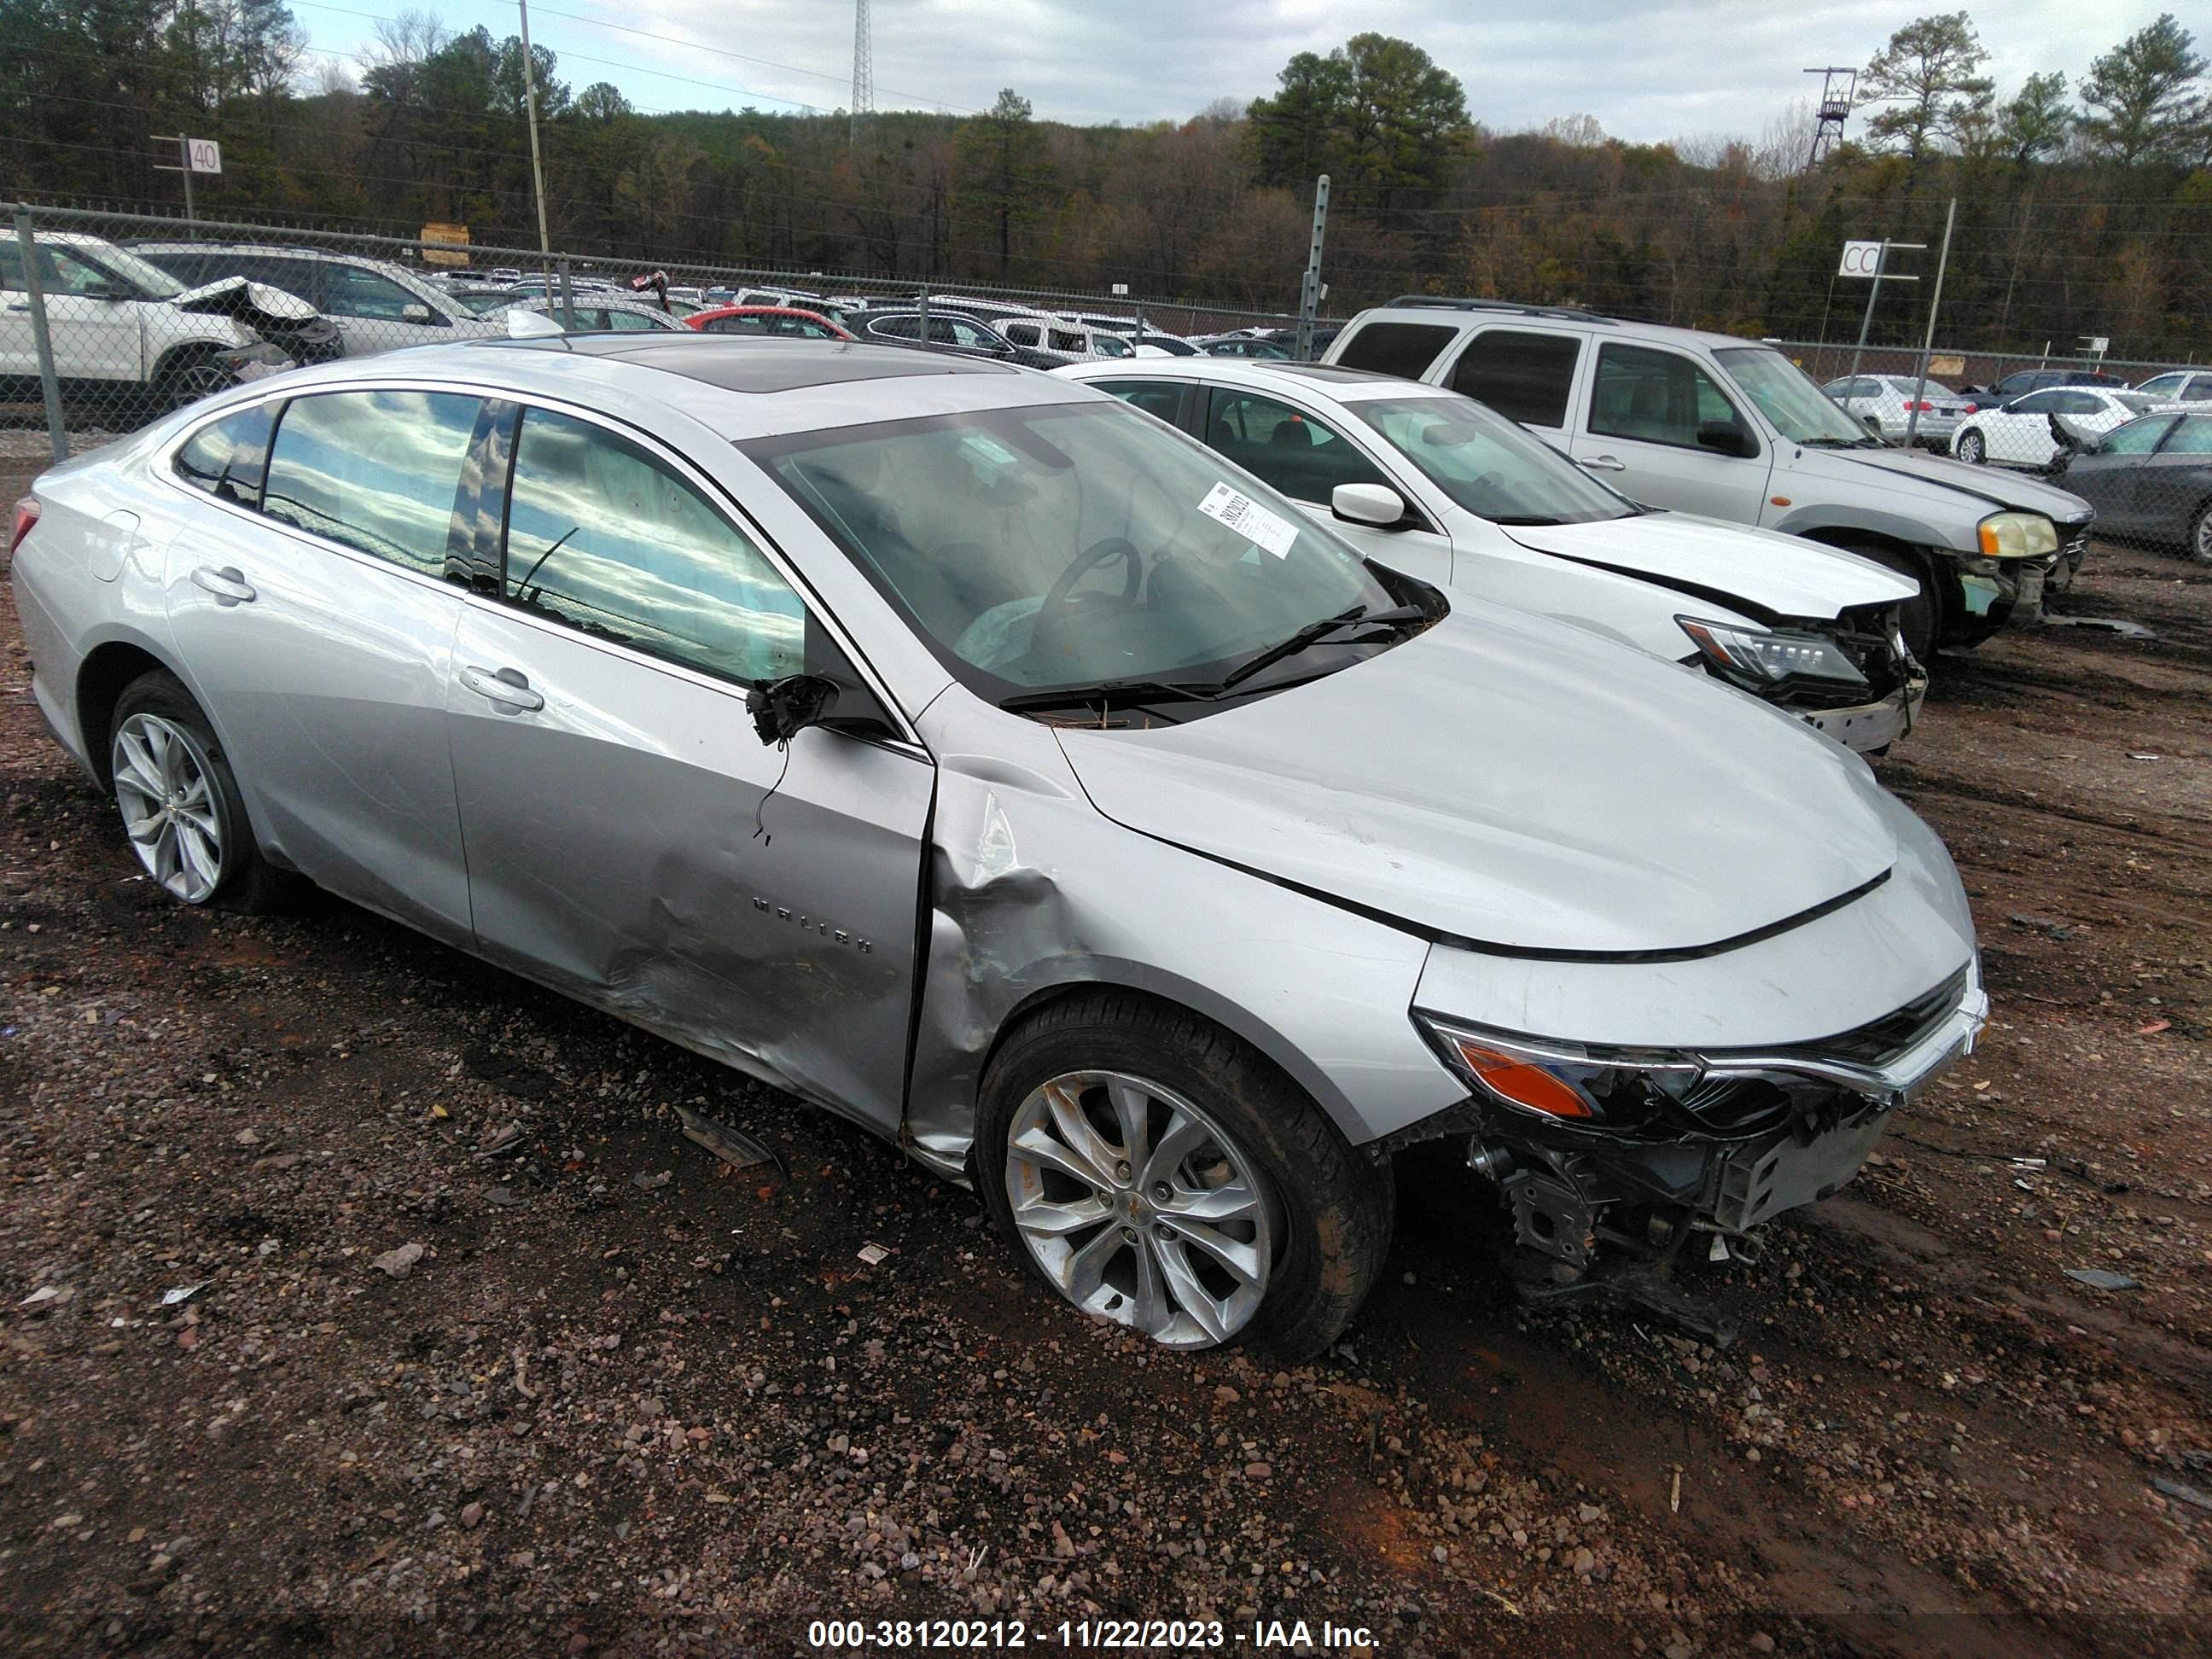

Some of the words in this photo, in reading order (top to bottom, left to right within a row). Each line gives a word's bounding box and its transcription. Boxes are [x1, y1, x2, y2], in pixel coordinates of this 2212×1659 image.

[195, 144, 216, 169] 40
[1843, 246, 1878, 273] CC
[1220, 494, 1249, 526] 38120212
[753, 897, 872, 954] MALIBU
